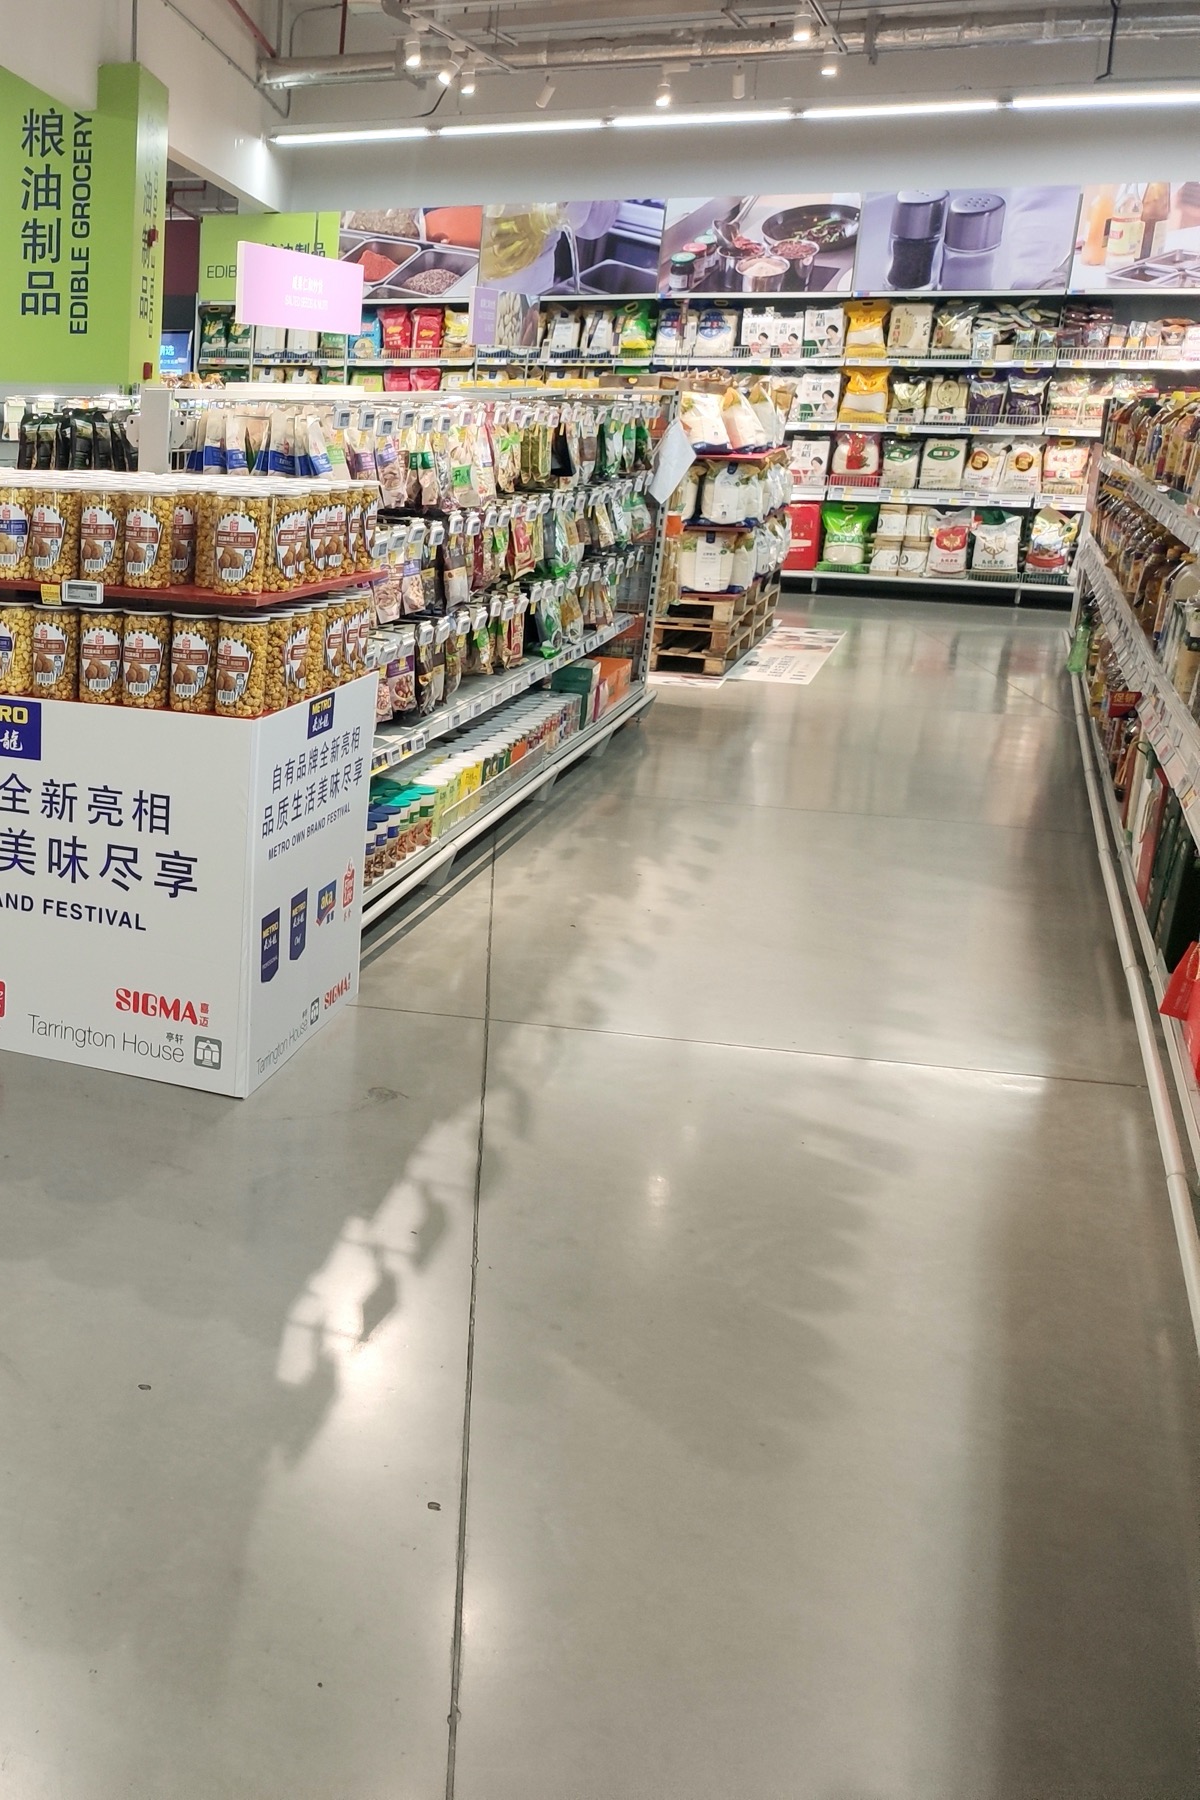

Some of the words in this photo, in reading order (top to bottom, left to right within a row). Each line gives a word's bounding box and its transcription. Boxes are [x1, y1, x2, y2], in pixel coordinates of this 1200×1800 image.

[71, 112, 93, 239] GROCERY
[21, 108, 65, 316] 粮油制品
[69, 247, 90, 334] EDIBLE
[311, 697, 332, 716] METRO
[272, 726, 361, 794] 自有品牌全新亮相
[262, 756, 364, 840] 品质生活美味尽享
[268, 838, 291, 861] METRO
[291, 828, 305, 846] OWN
[306, 817, 326, 838] BRAND
[326, 802, 351, 828] FESTIVAL
[42, 898, 147, 932] FESTIVAL
[320, 891, 333, 910] aka
[262, 921, 279, 939] METRO
[115, 987, 198, 1025] SIGMA
[324, 976, 348, 1010] SIGMA
[27, 1013, 116, 1049] Tarrington
[122, 1032, 185, 1063] House
[165, 1032, 184, 1045] 亭轩
